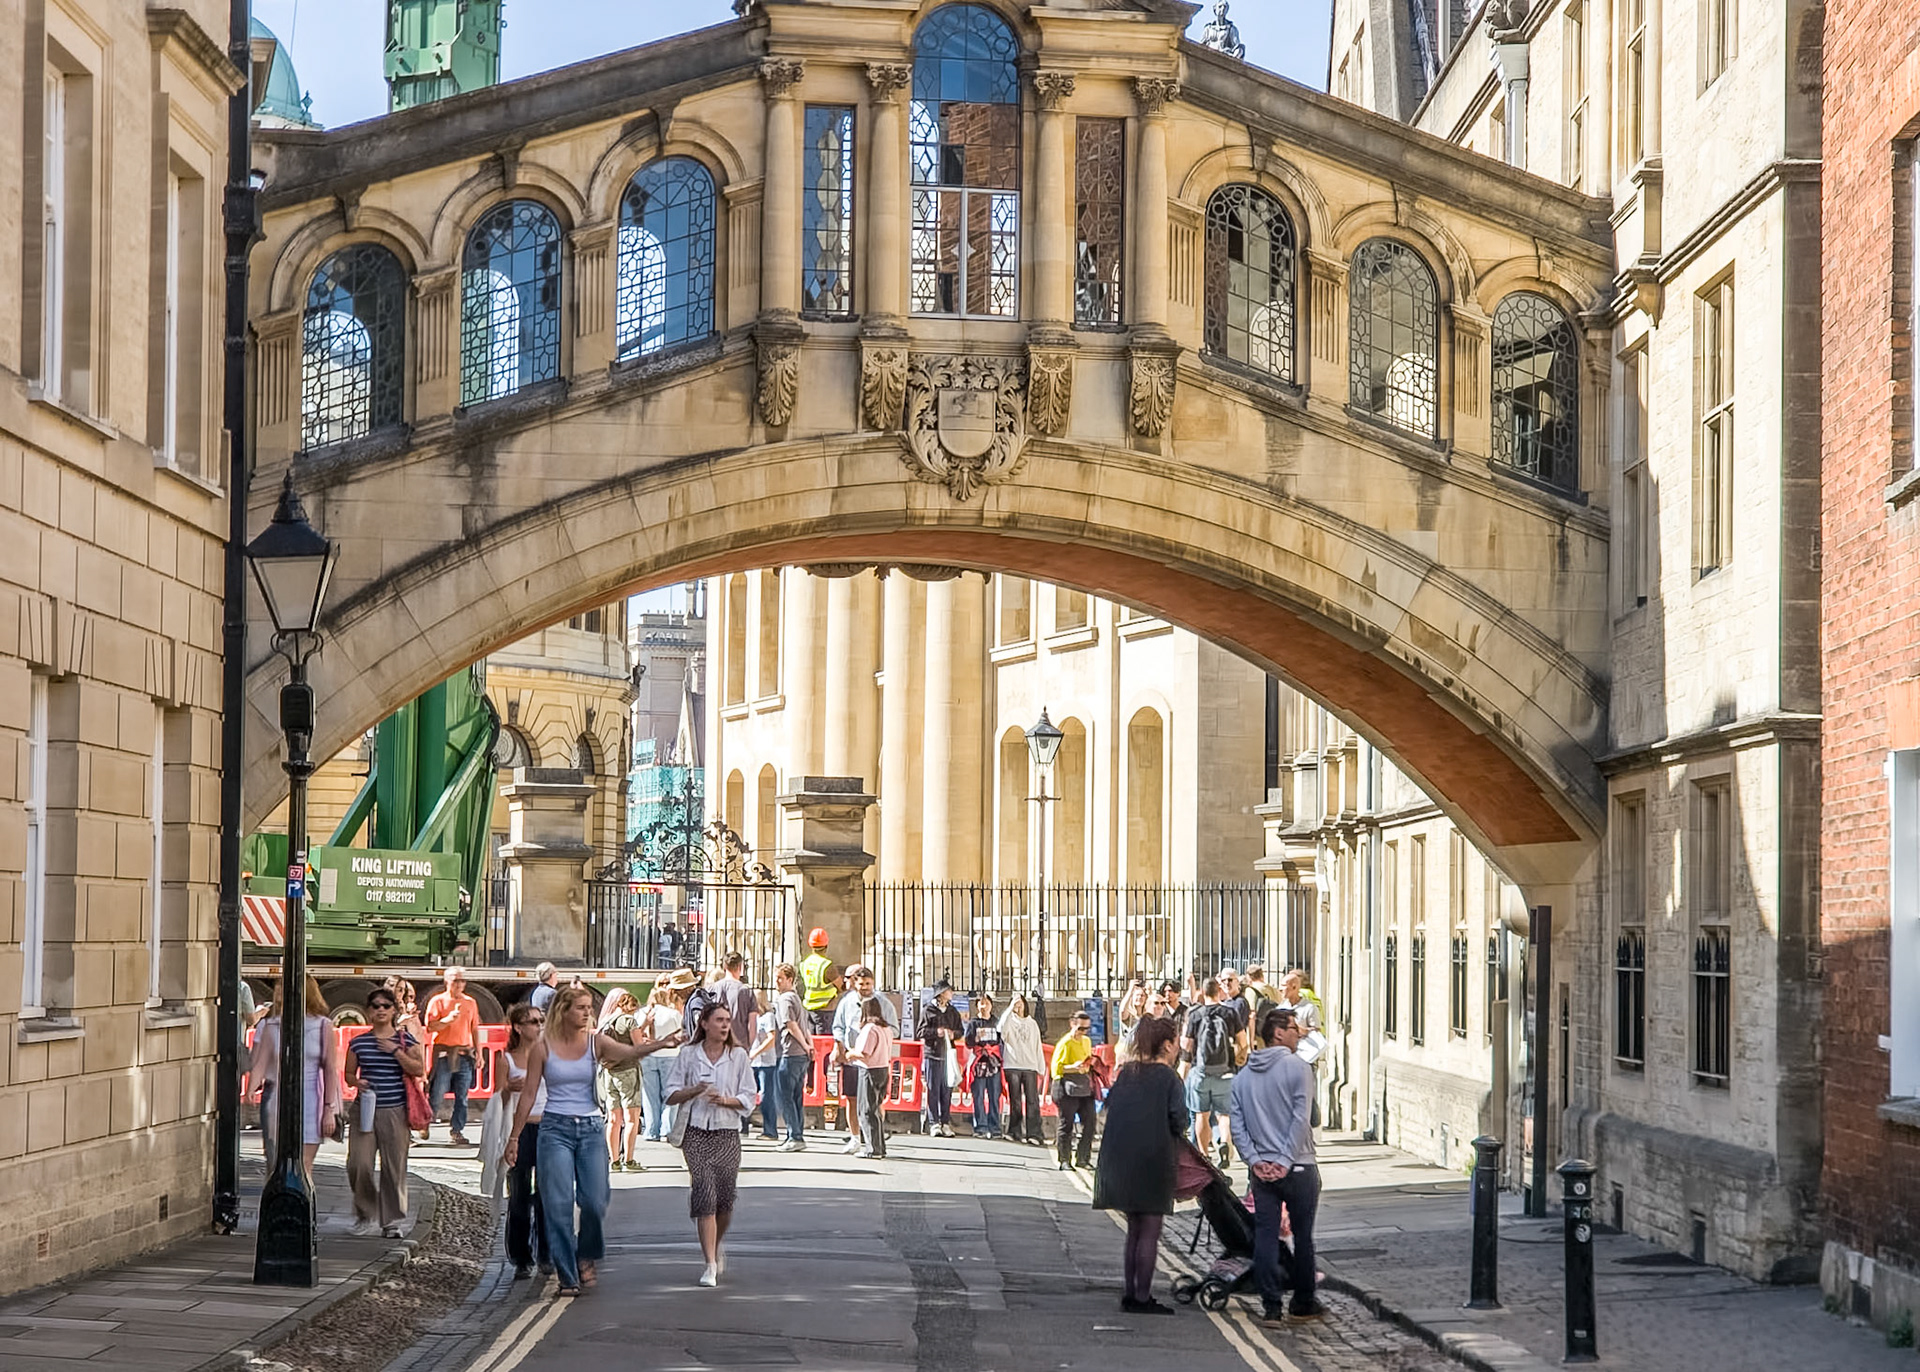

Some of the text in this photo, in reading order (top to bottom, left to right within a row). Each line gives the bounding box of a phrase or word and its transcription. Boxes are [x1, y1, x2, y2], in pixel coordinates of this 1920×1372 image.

[351, 857, 432, 877] KING LIFTING
[357, 876, 425, 889] DEPOTS NATIONWIDE
[366, 890, 416, 903] 0117 9821121
